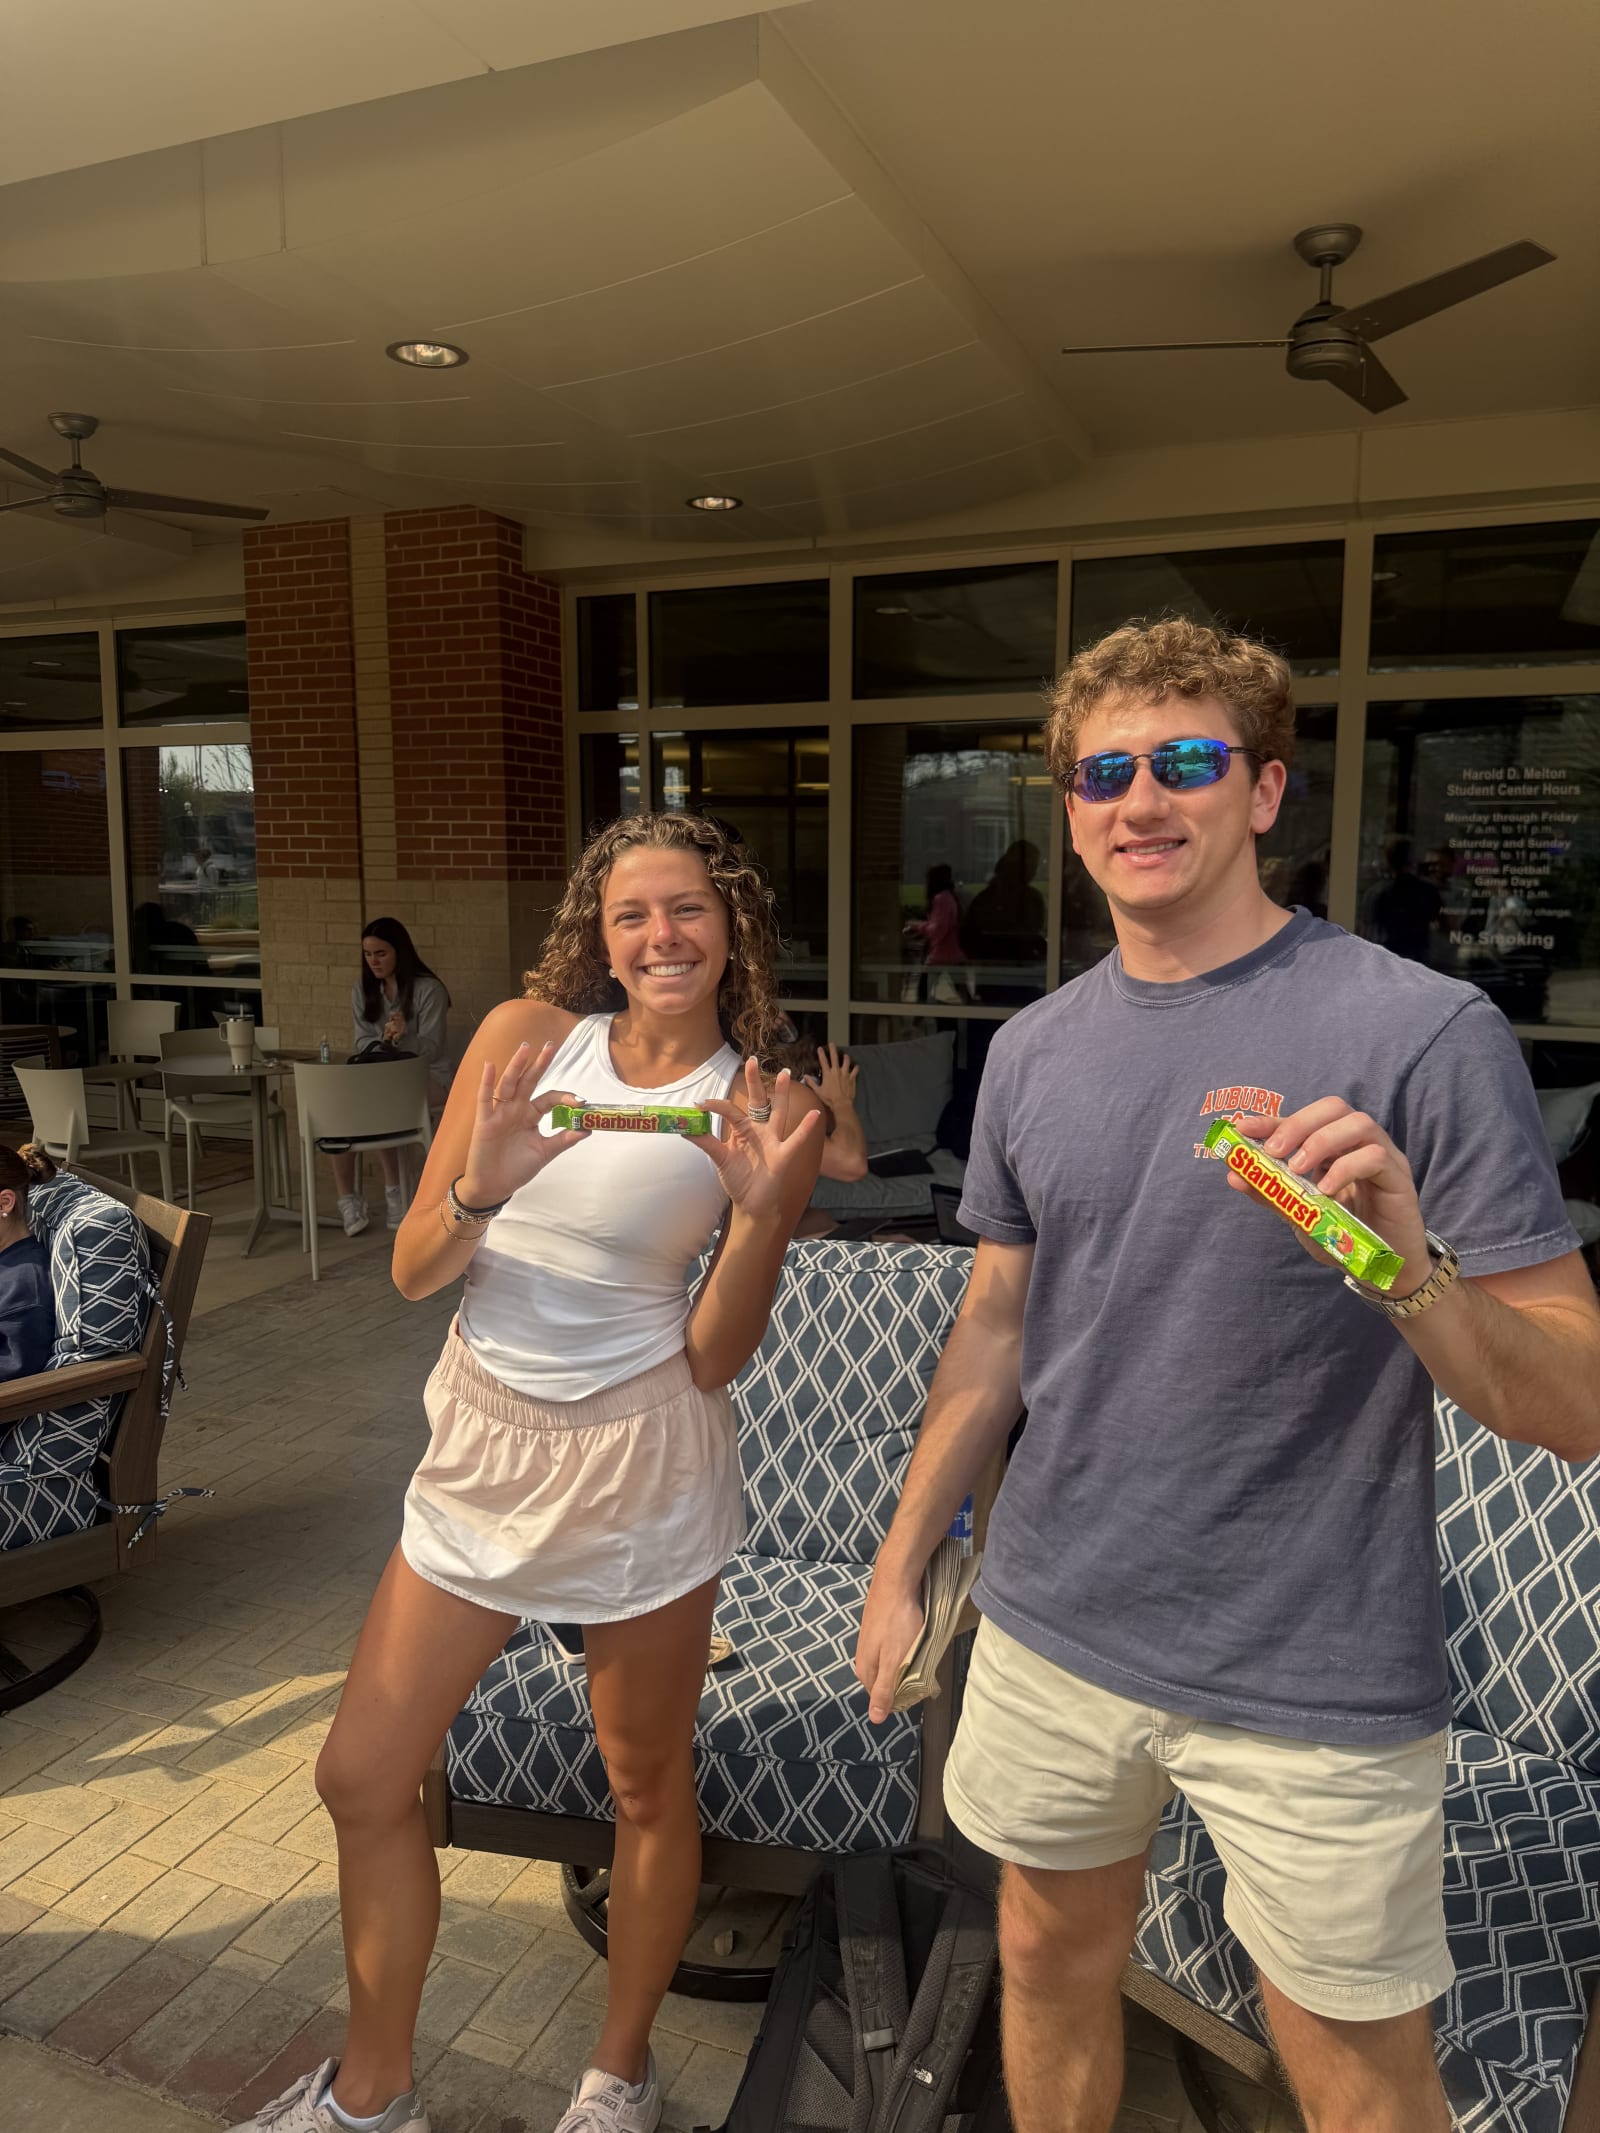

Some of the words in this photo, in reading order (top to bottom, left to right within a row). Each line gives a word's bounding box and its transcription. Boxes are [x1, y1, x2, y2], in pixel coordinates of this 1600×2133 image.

[1462, 768, 1504, 780] Harold
[1507, 768, 1519, 779] D.
[1523, 767, 1566, 779] Melton
[1447, 783, 1494, 796] Student
[1498, 783, 1539, 796] Center
[1542, 783, 1580, 795] Hours
[1445, 812, 1490, 824] Monday
[1493, 811, 1538, 825] through
[1541, 811, 1578, 824] Friday
[1502, 825, 1513, 834] to
[1517, 824, 1527, 834] 11
[1449, 838, 1499, 850] Saturday
[1503, 838, 1525, 848] and
[1527, 838, 1571, 850] Sunday
[1466, 864, 1499, 875] Home
[1502, 864, 1550, 875] Football
[1475, 876, 1507, 887] Game
[1510, 876, 1540, 889] Days
[1449, 930, 1472, 945] No
[1478, 930, 1554, 949] Smoking
[1199, 1085, 1284, 1118] AUBURN
[583, 1113, 659, 1131] Starburst
[1218, 1139, 1231, 1152] 240
[1229, 1145, 1321, 1230] Starburst
